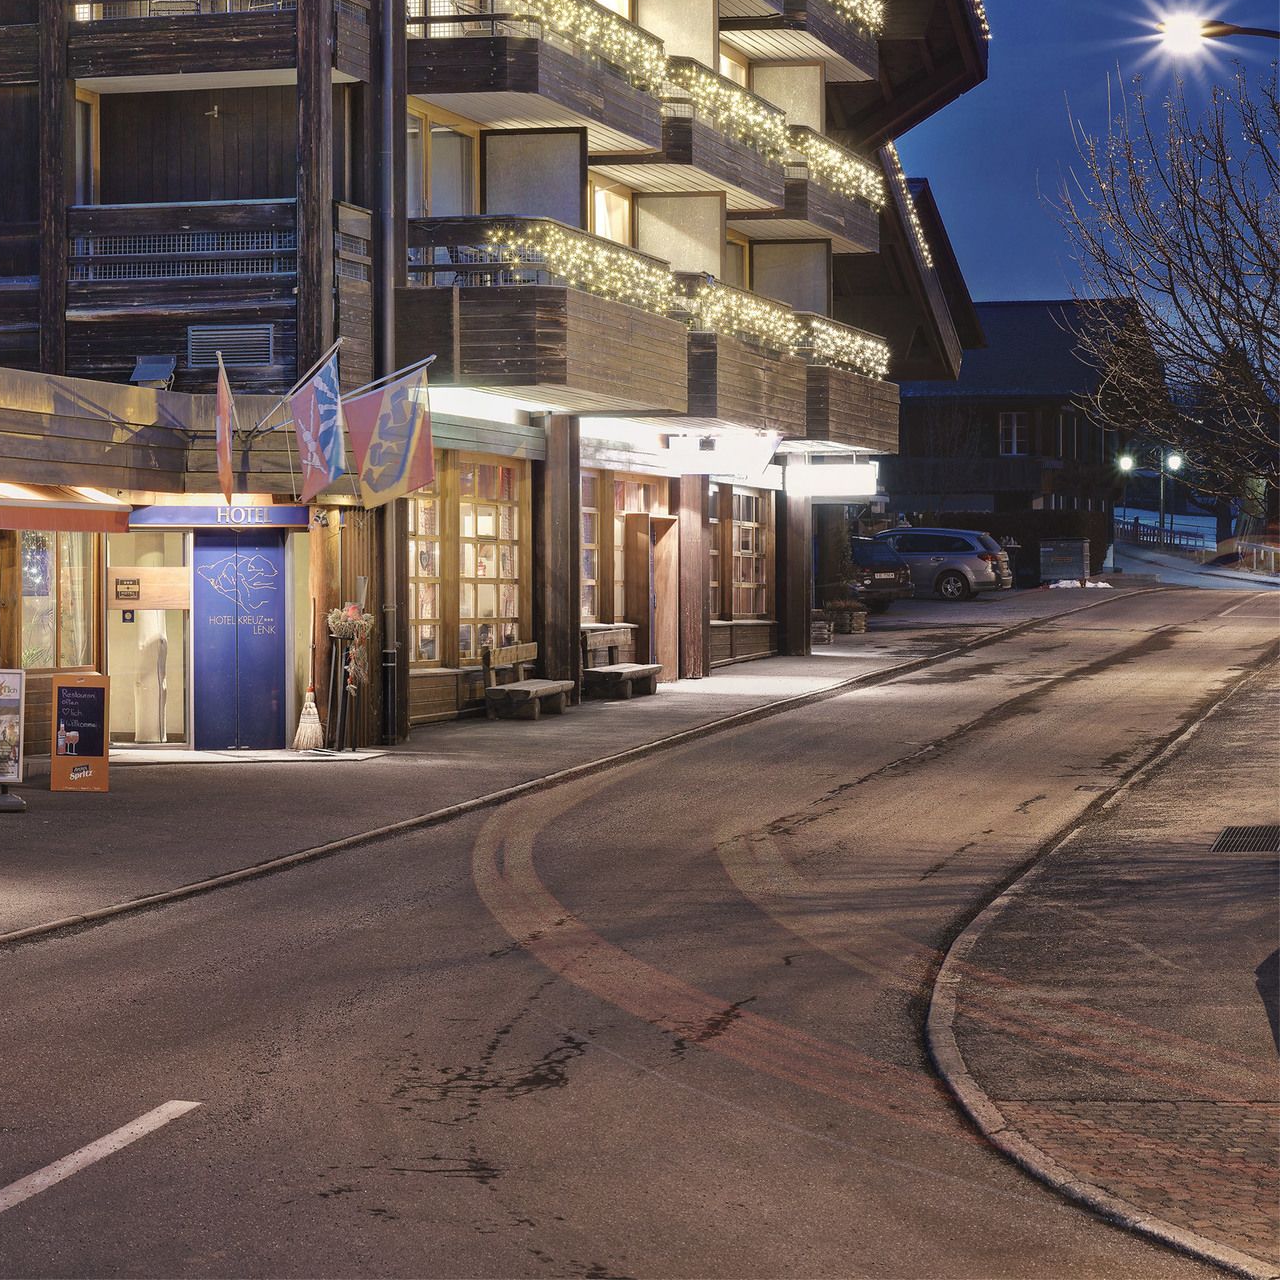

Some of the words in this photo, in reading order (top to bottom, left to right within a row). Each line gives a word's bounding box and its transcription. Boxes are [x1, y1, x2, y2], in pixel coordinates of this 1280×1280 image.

[216, 507, 272, 524] HOTEL
[209, 616, 236, 625] HOTEL
[238, 615, 264, 625] KREUZ
[253, 625, 276, 634] LENK
